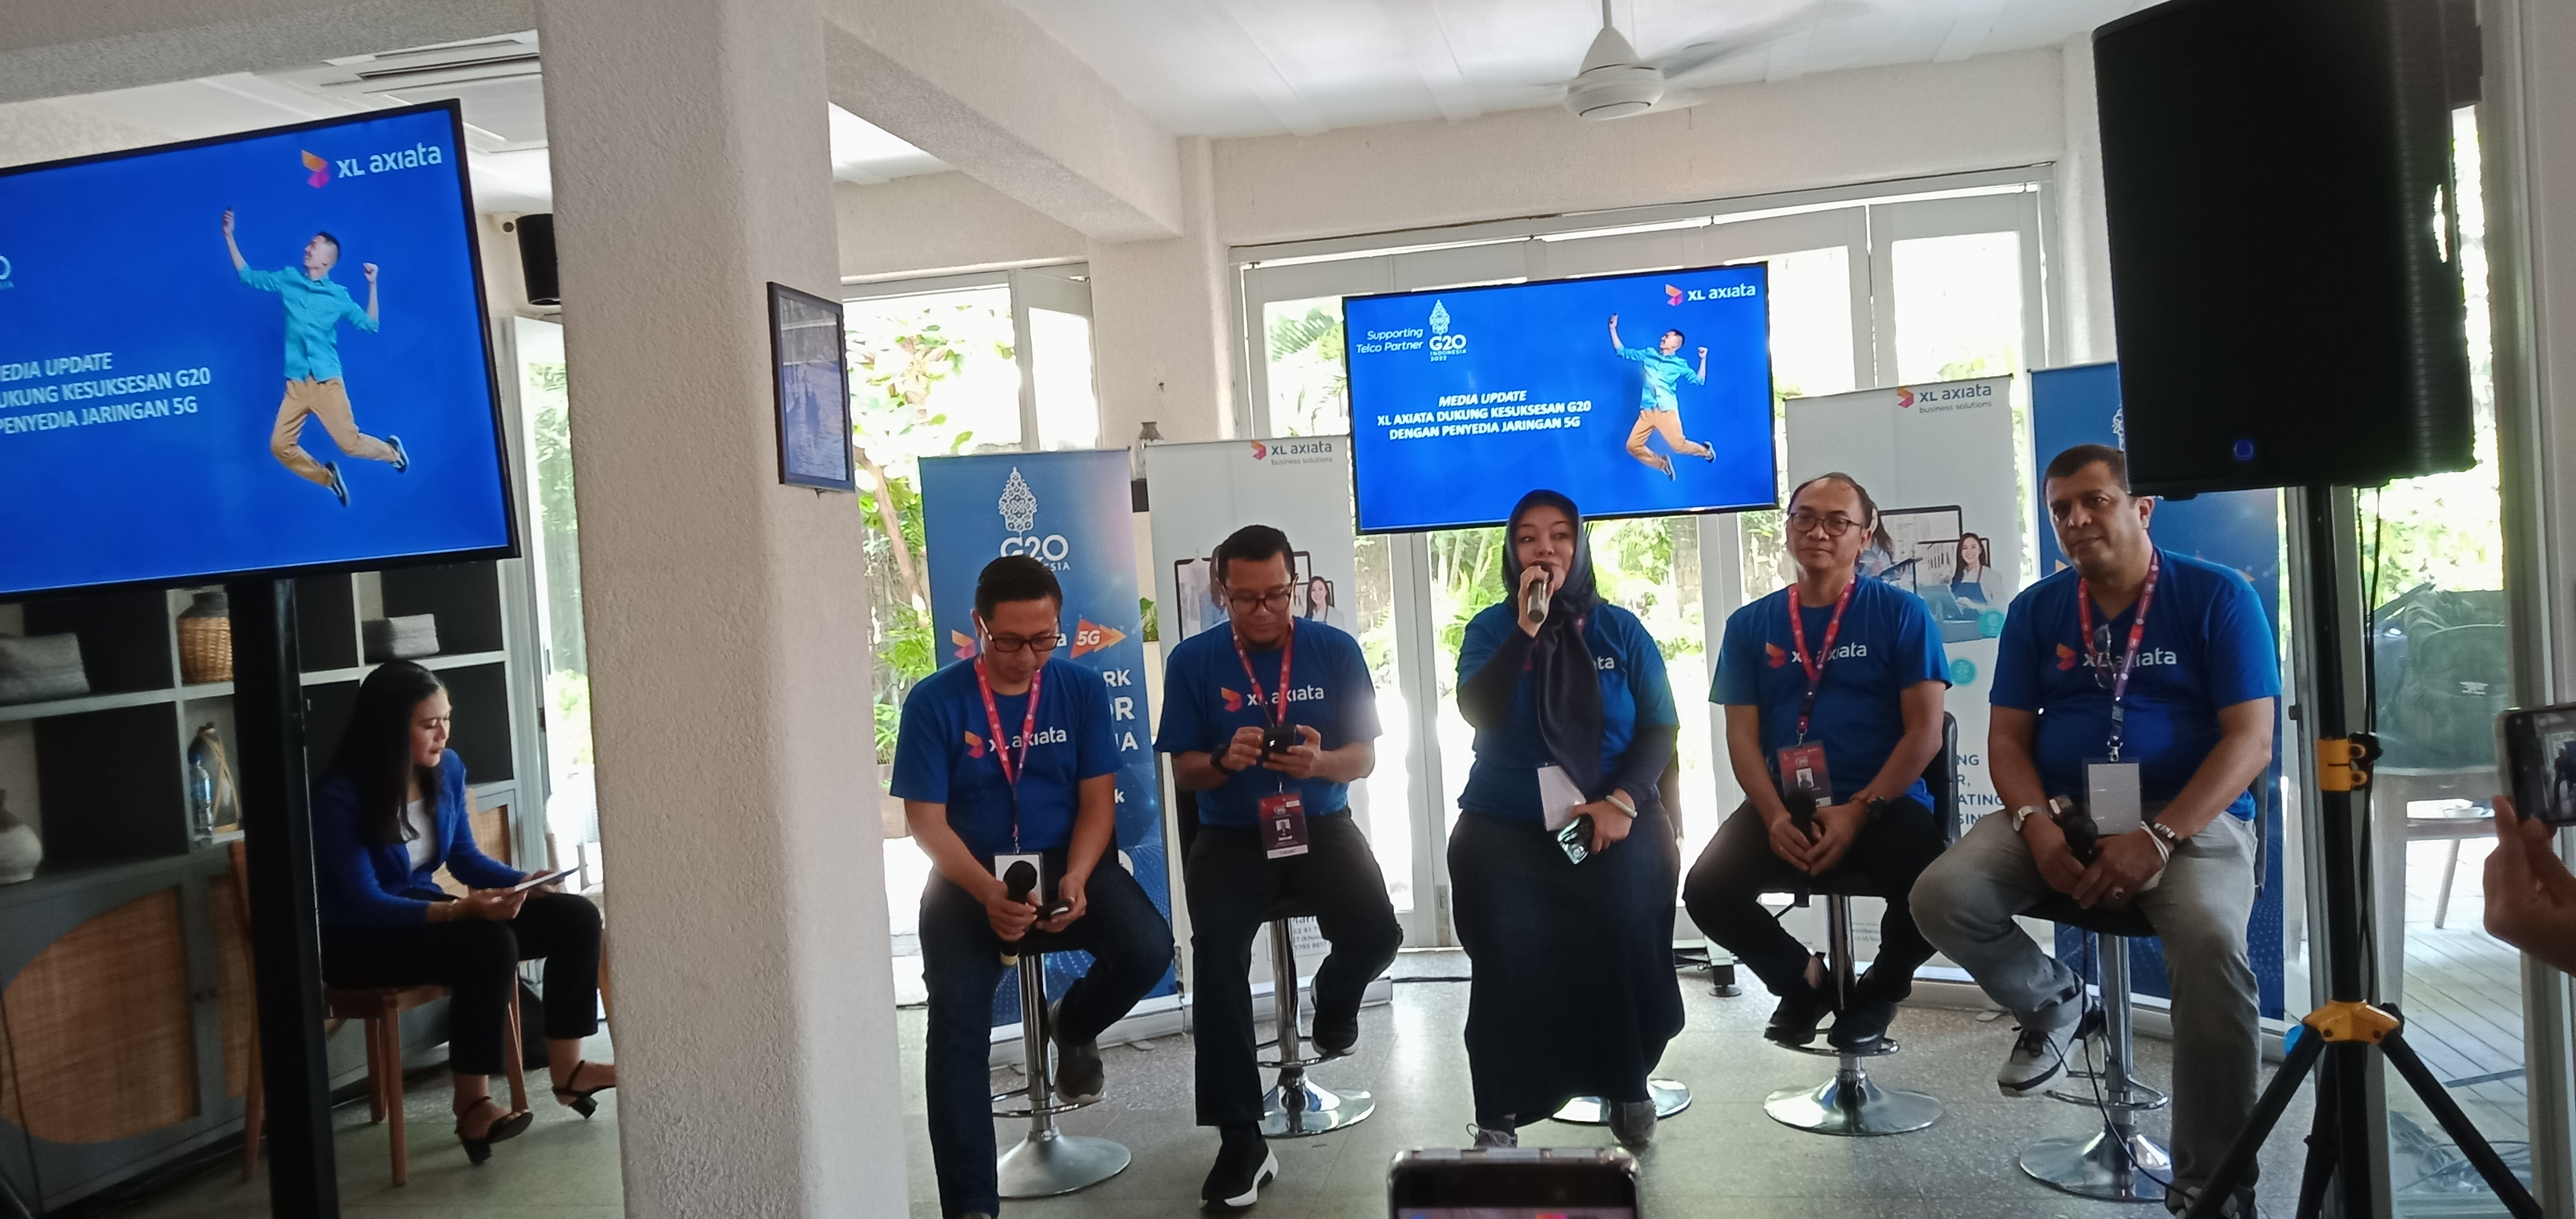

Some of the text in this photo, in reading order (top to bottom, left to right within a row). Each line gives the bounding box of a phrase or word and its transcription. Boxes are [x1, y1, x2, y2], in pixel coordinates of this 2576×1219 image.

[336, 142, 442, 178] XL axiata
[1687, 282, 1756, 302] XL axiata
[1367, 328, 1424, 341] Supporting
[1429, 334, 1467, 351] G20
[1355, 341, 1424, 354] Telco Partner
[0, 352, 113, 382] EDIA UPDATE
[61, 372, 173, 401] KESUKSESAN
[175, 367, 211, 388] G20
[1920, 383, 1992, 403] XL axiata
[1438, 390, 1527, 408] MEDIA UPDATE
[1956, 401, 1993, 410] solutions
[81, 400, 170, 426] JARINGAN
[173, 396, 198, 416] 5G
[1377, 400, 1592, 426] XL AXIATA DUKUNG KESUKSESAN G20
[1389, 416, 1581, 440] DENGAN PENYEDIA JARINGAN 5G
[1271, 440, 1332, 455] XL axiata
[1076, 629, 1101, 646] 5G
